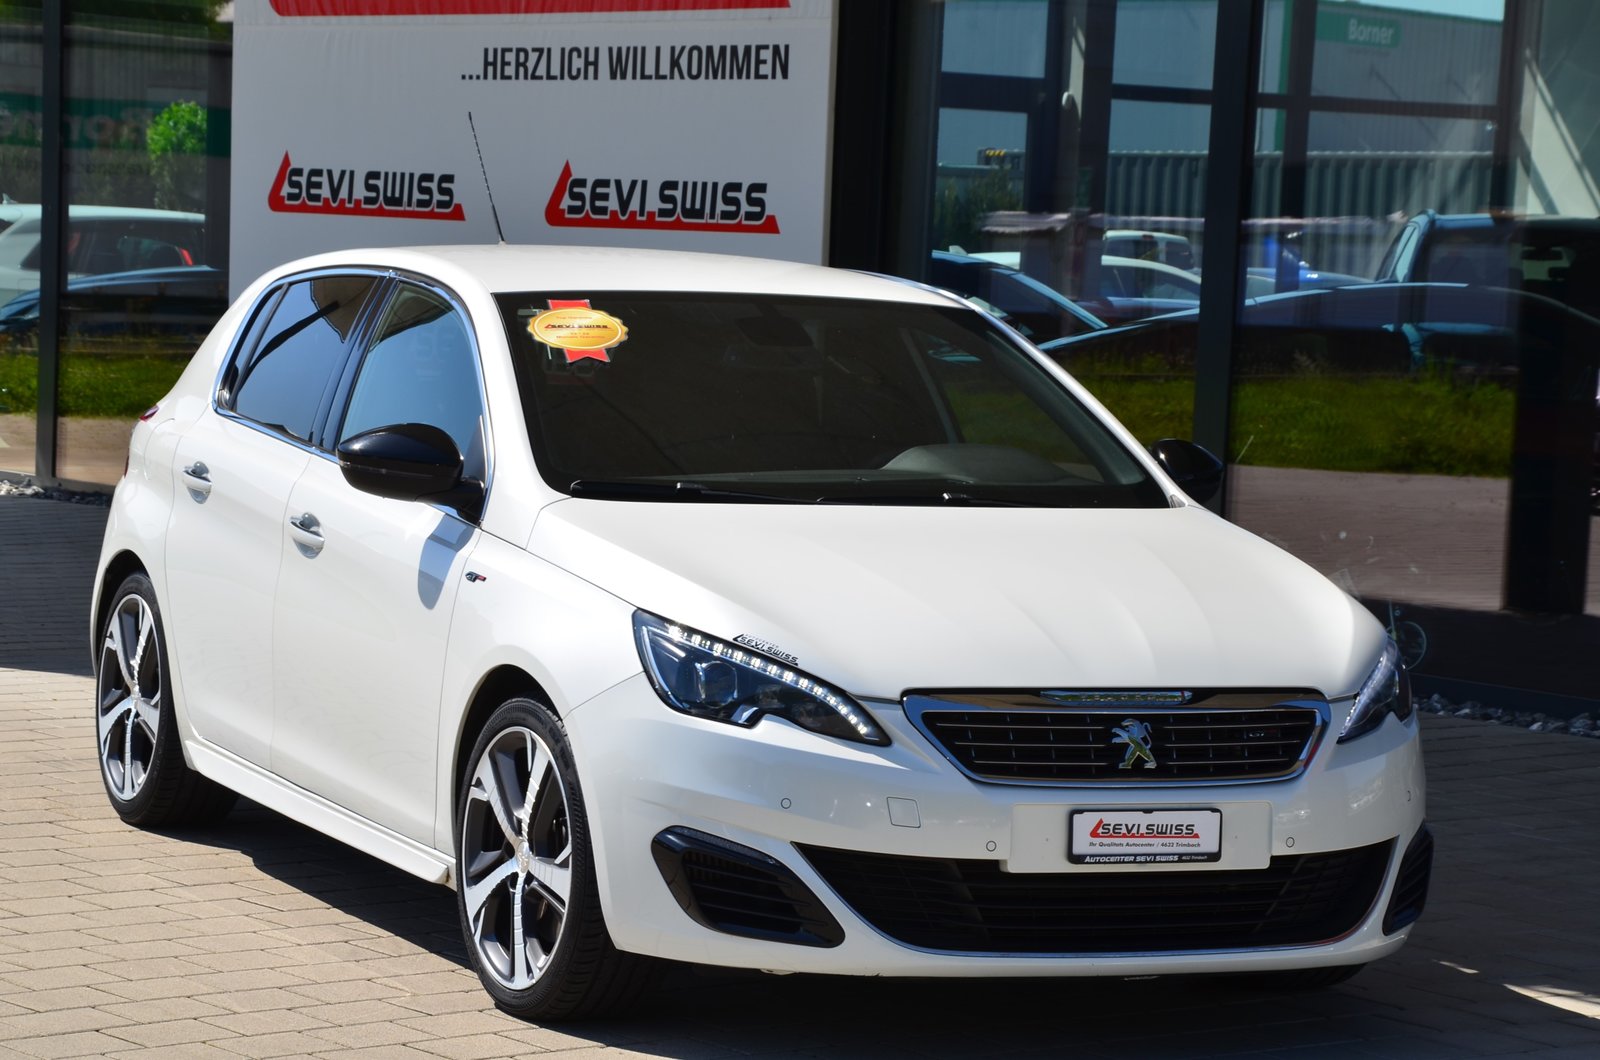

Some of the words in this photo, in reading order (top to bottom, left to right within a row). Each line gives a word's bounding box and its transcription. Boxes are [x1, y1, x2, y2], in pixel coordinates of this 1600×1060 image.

[461, 46, 599, 81] ...HERZLICH
[608, 44, 790, 80] WILLKOMMEN
[286, 167, 355, 205] SEVI
[363, 171, 455, 210] SWISS
[566, 178, 648, 218] SEVI
[657, 180, 767, 222] SWISS
[740, 636, 766, 650] SEVI
[767, 646, 799, 663] SWISS
[1101, 823, 1140, 835] SEVI
[1145, 823, 1195, 835] SWISS
